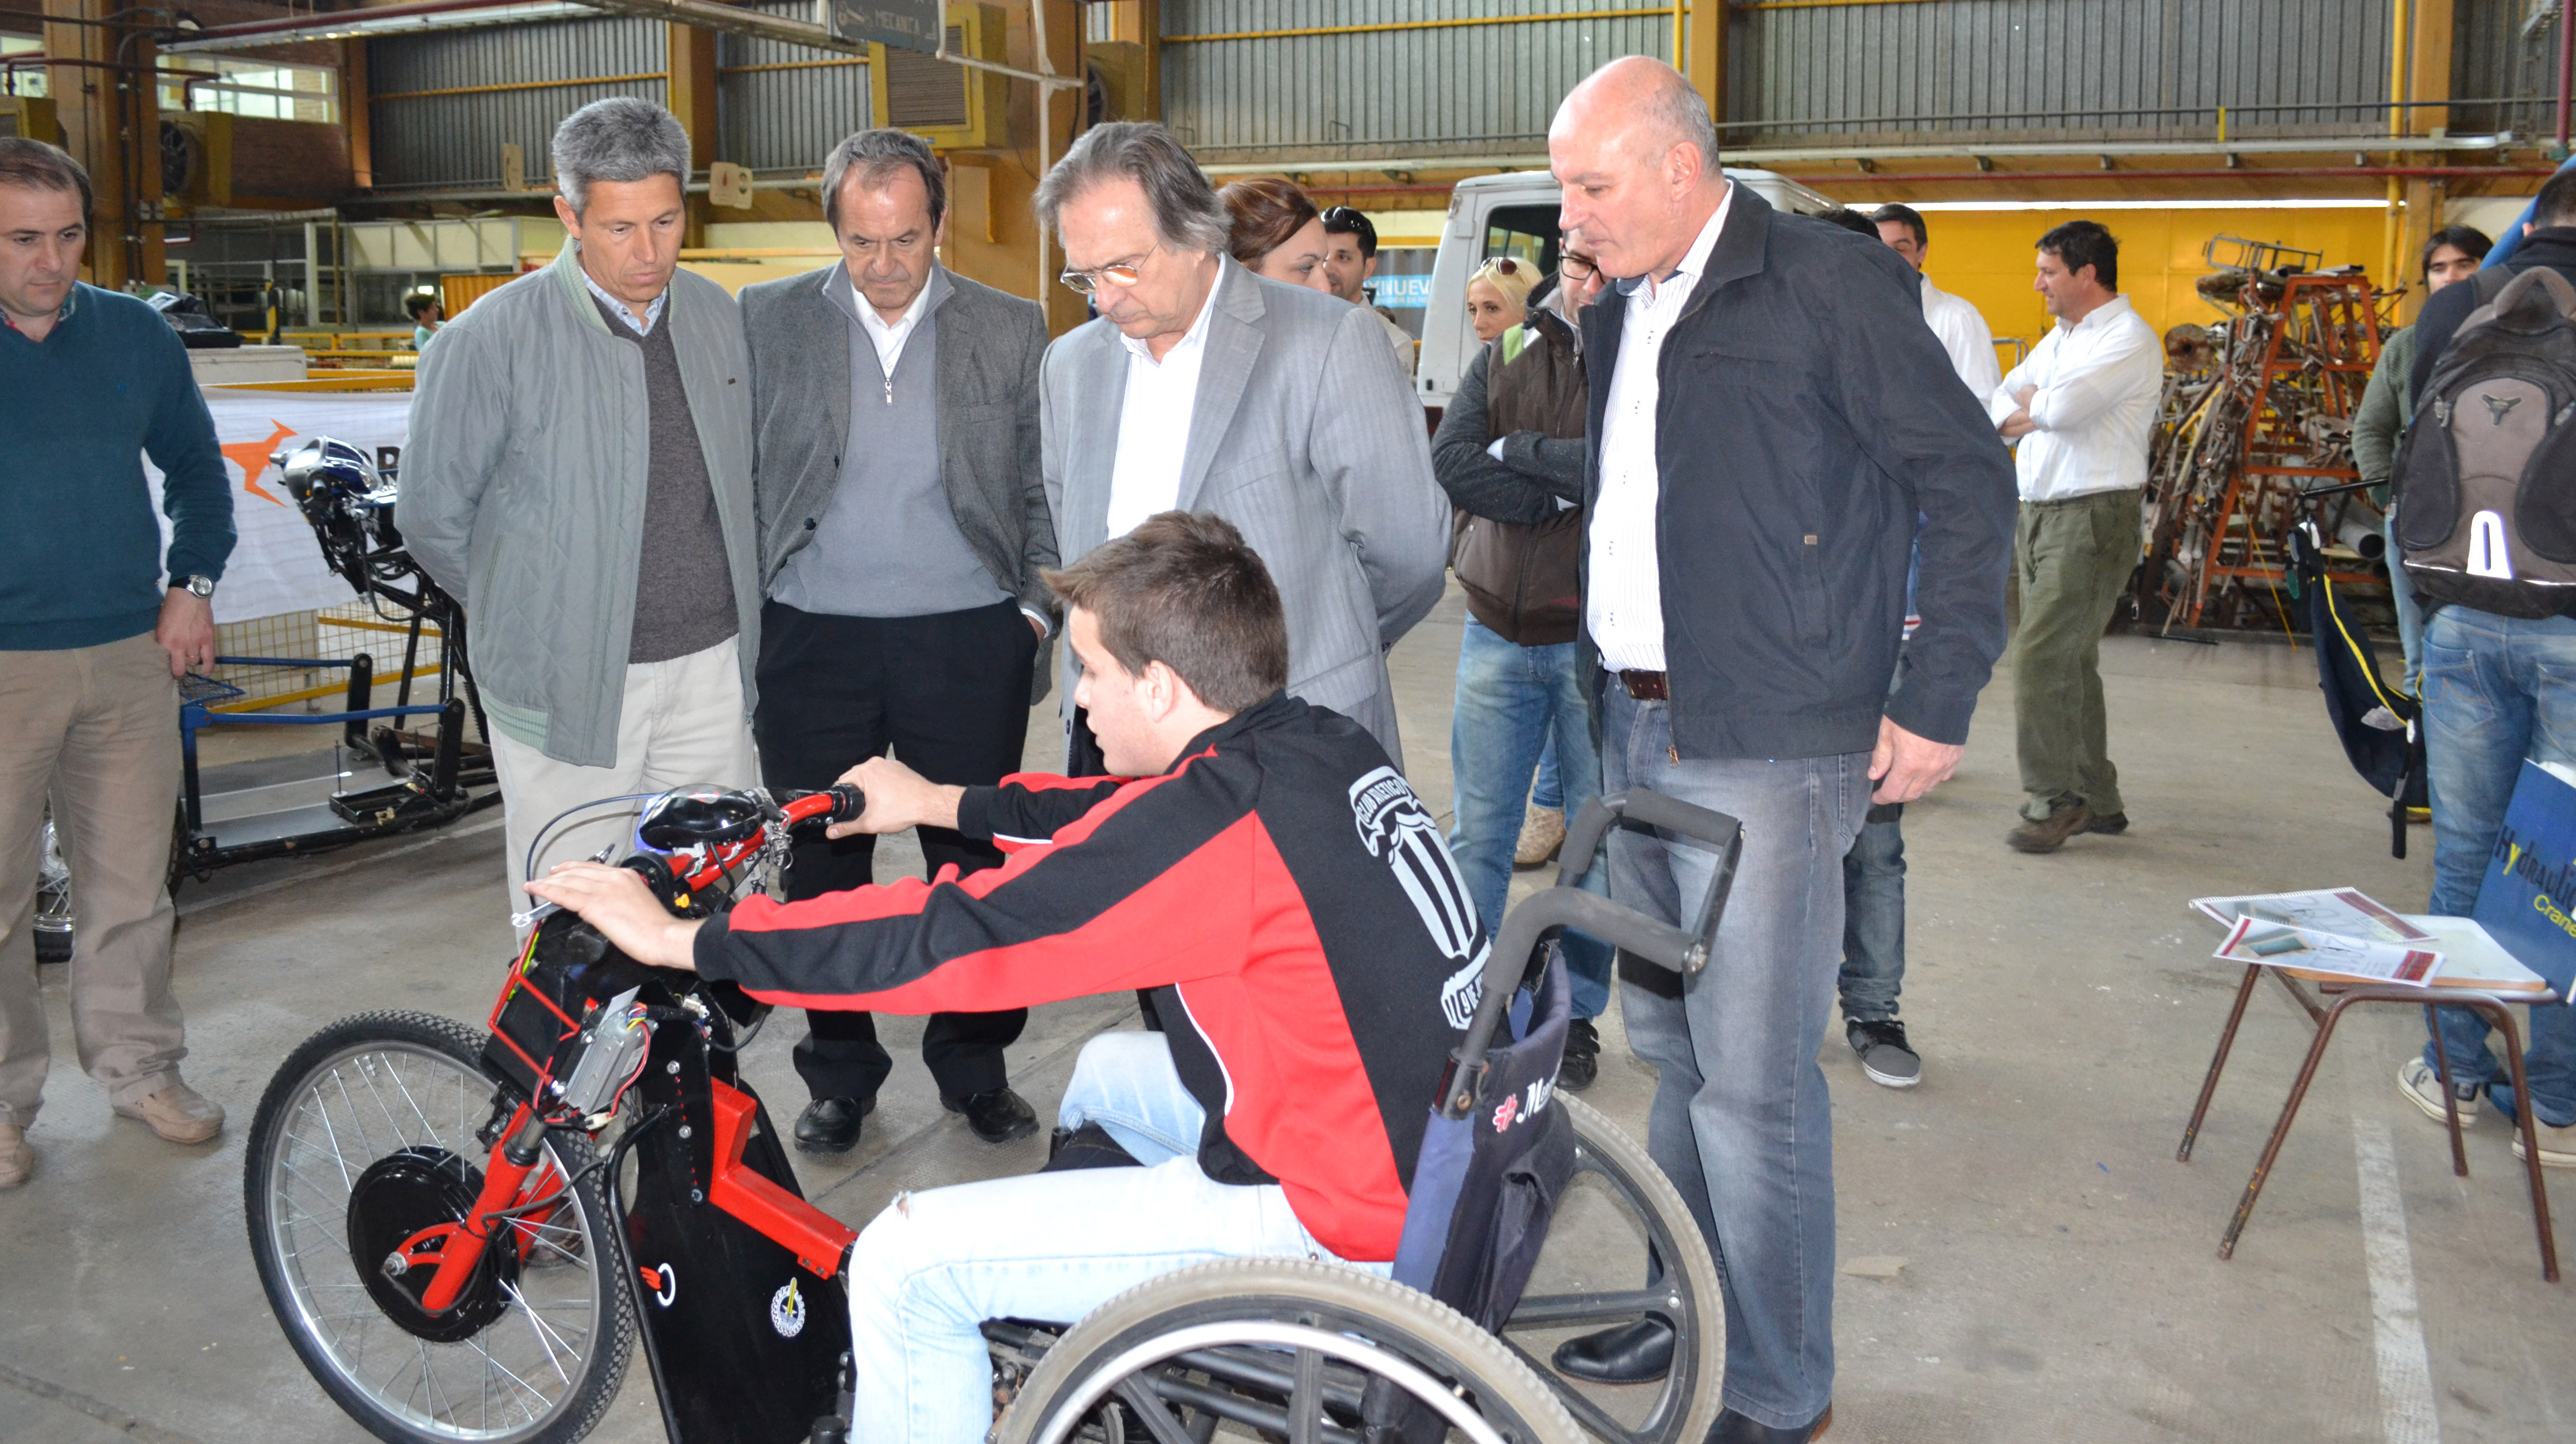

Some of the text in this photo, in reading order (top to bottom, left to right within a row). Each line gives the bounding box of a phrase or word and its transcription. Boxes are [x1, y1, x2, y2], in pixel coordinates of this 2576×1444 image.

[1356, 779, 1407, 823] CLUB ATLETICO
[1460, 991, 1471, 1014] 9
